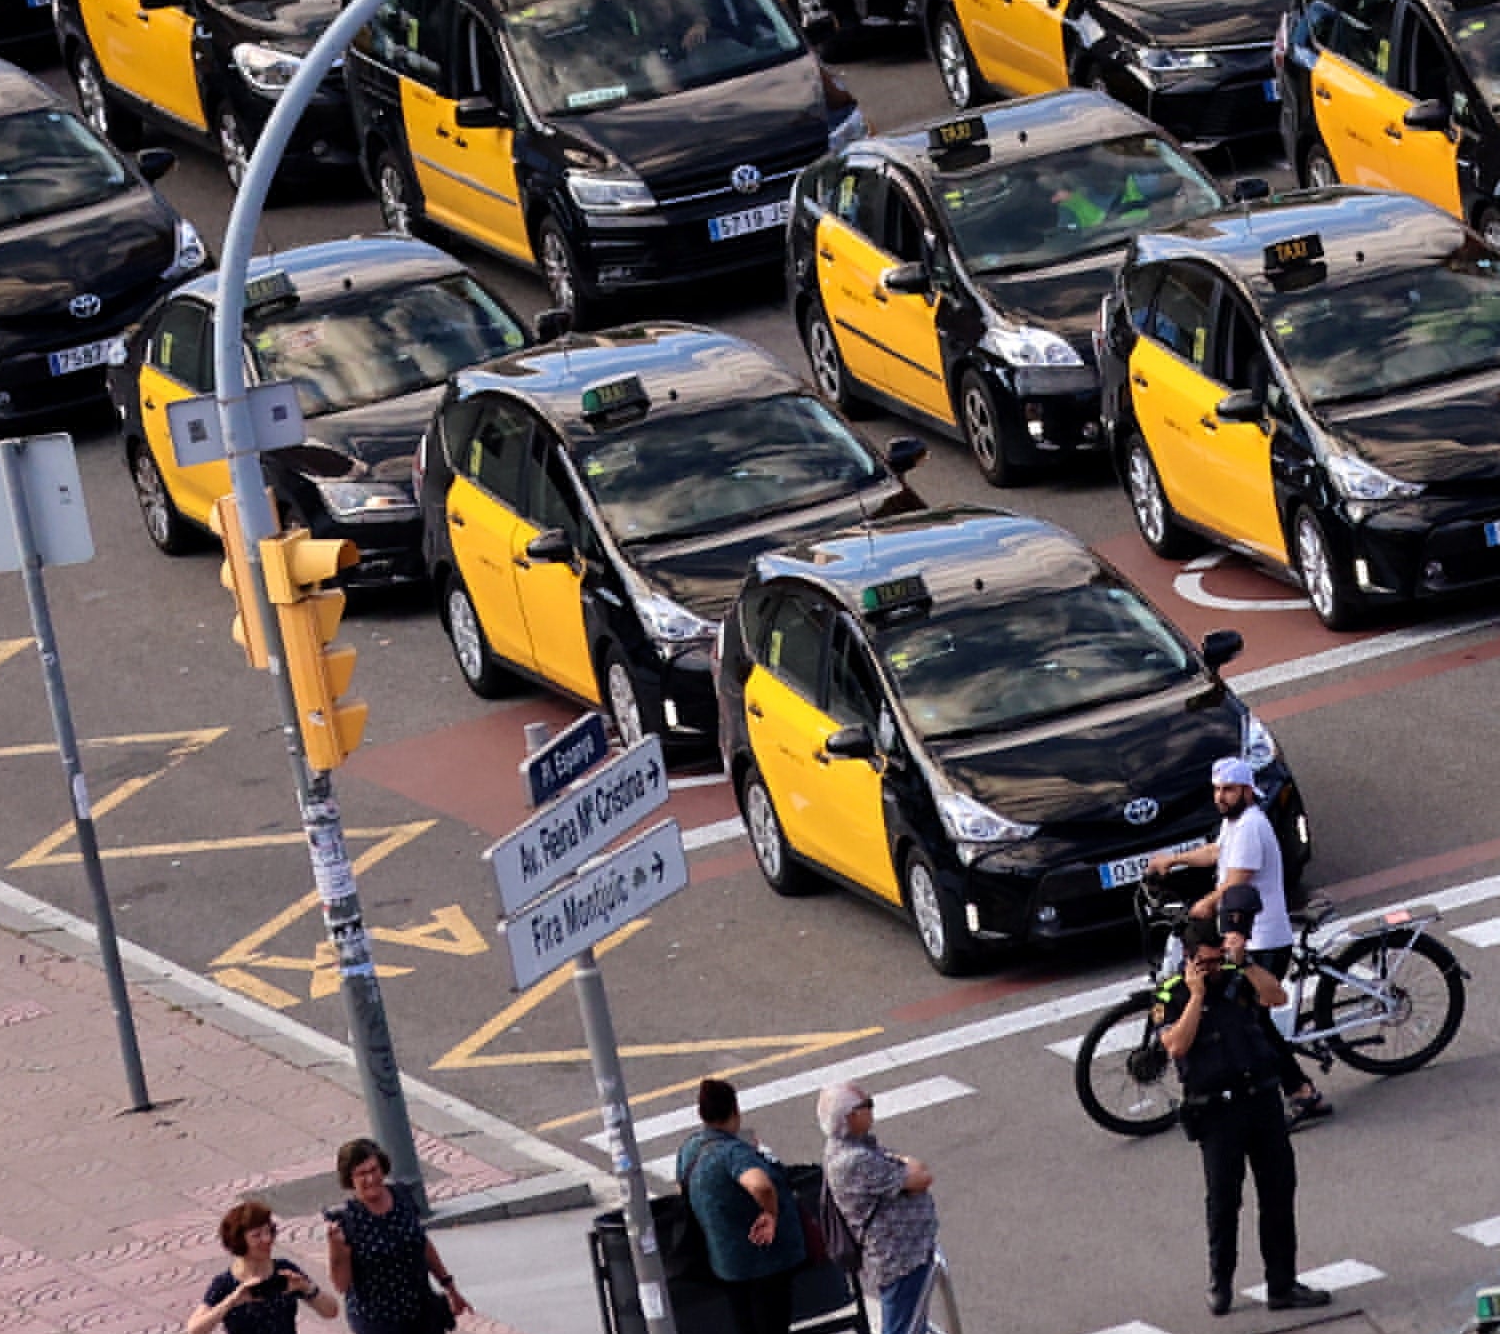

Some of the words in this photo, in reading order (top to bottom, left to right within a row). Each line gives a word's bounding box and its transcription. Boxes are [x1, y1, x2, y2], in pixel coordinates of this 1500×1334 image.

[940, 121, 970, 140] TAXI
[1275, 241, 1306, 260] TAXI
[540, 817, 578, 862] Reina
[596, 769, 646, 825] Cristina
[531, 916, 564, 955] Fira
